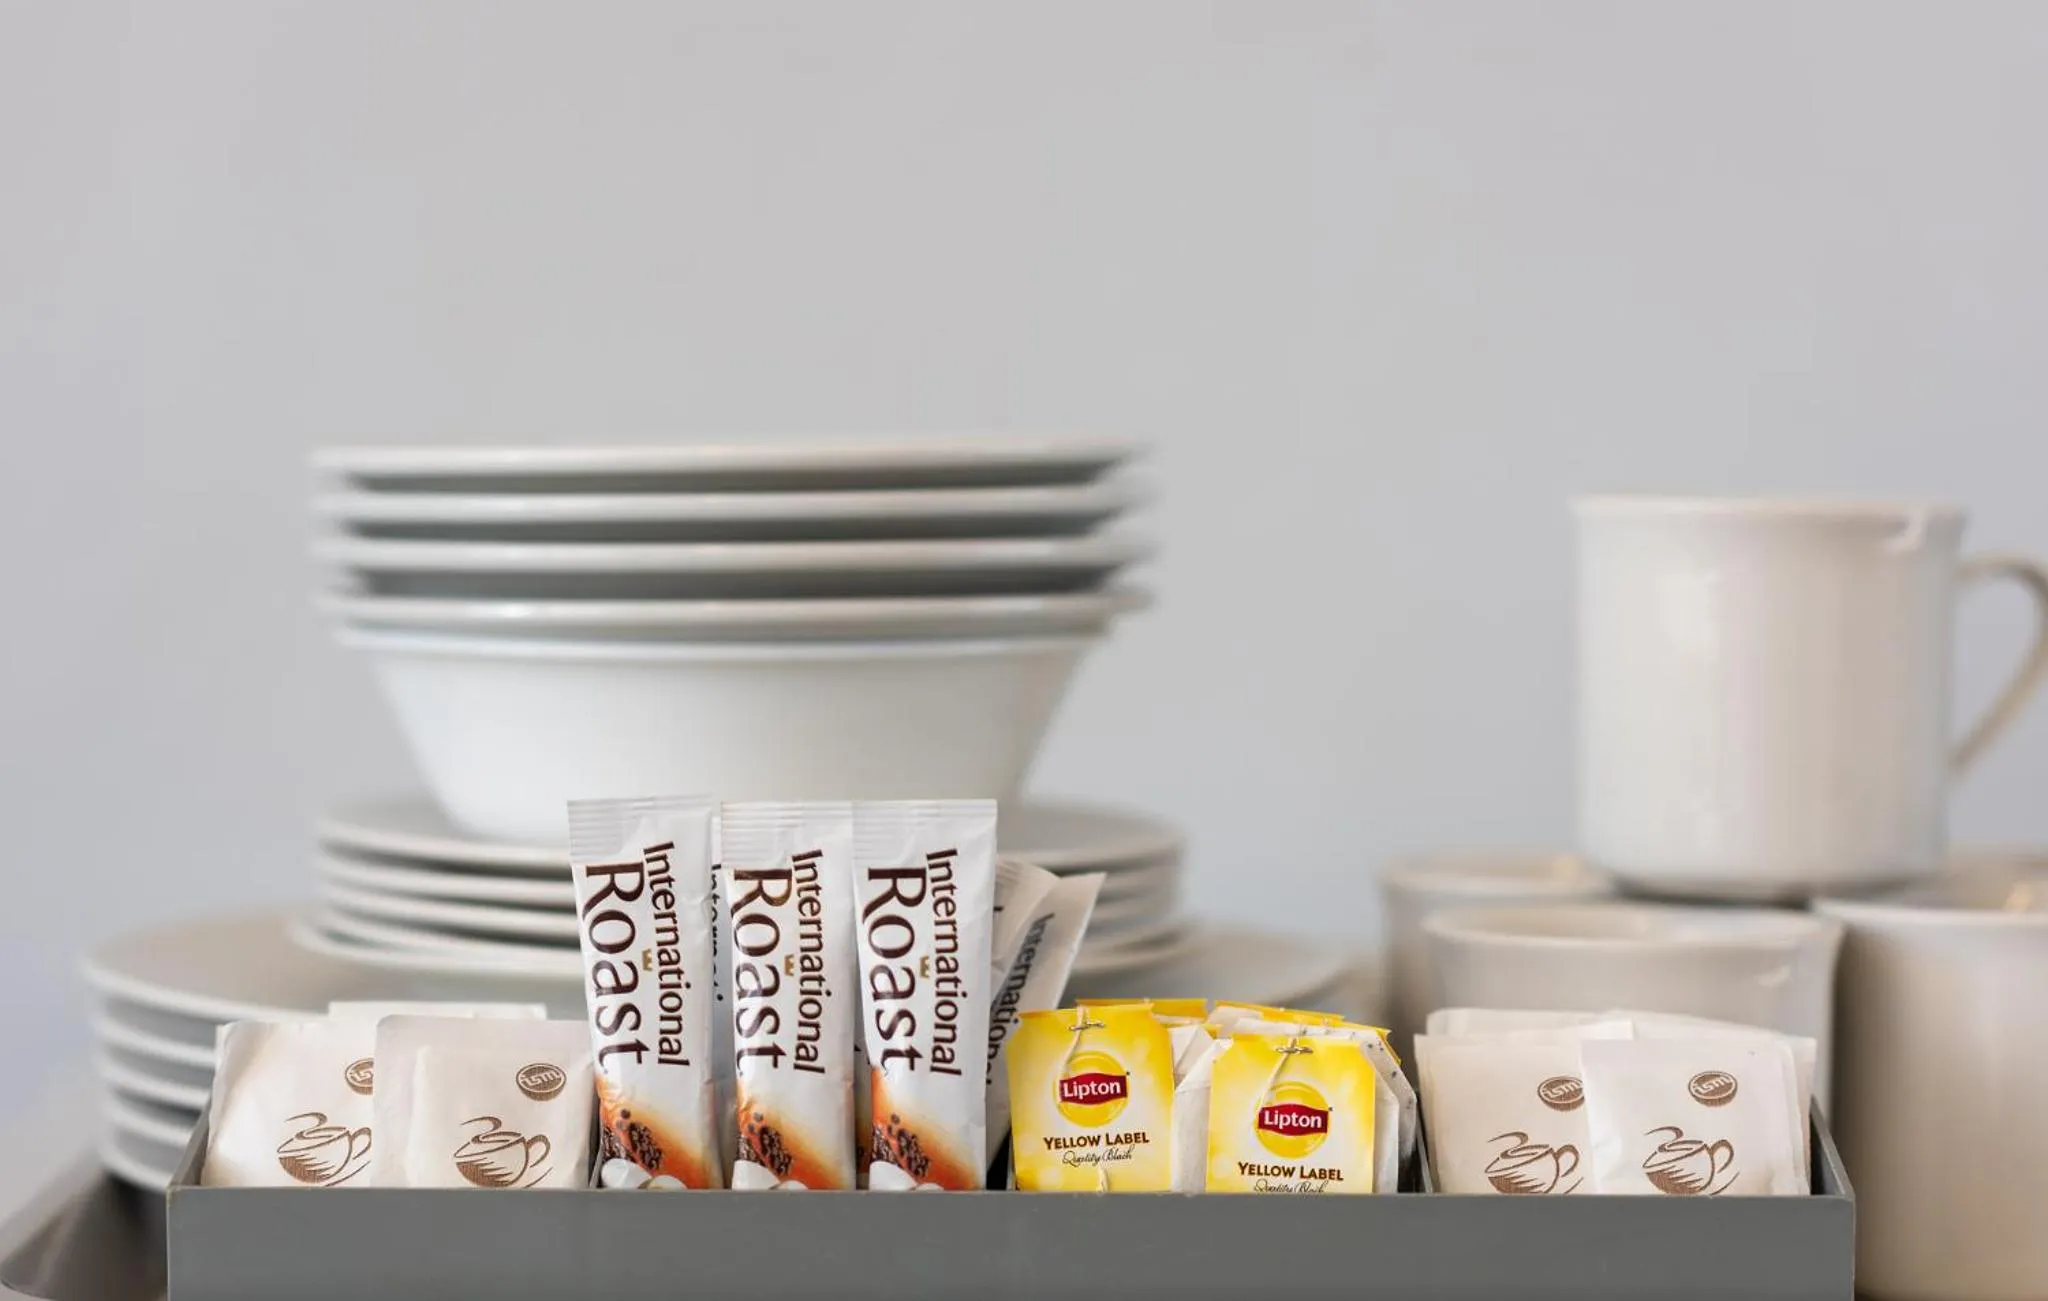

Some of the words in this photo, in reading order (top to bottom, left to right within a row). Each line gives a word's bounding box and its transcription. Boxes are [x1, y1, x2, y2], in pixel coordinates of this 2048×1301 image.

[582, 861, 650, 1070] Roast
[643, 840, 692, 1067] International
[731, 867, 793, 1073] Roast
[791, 848, 833, 1074] International
[861, 866, 927, 1073] Roast
[926, 847, 968, 1076] International
[985, 912, 1056, 1086] Internation
[1042, 1135, 1101, 1150] YELLOW
[1105, 1131, 1150, 1146] LABEL
[1062, 1080, 1122, 1100] Lipton
[1238, 1161, 1296, 1178] YELLOW
[1299, 1166, 1345, 1181] LABEL
[1263, 1109, 1323, 1130] Lipton
